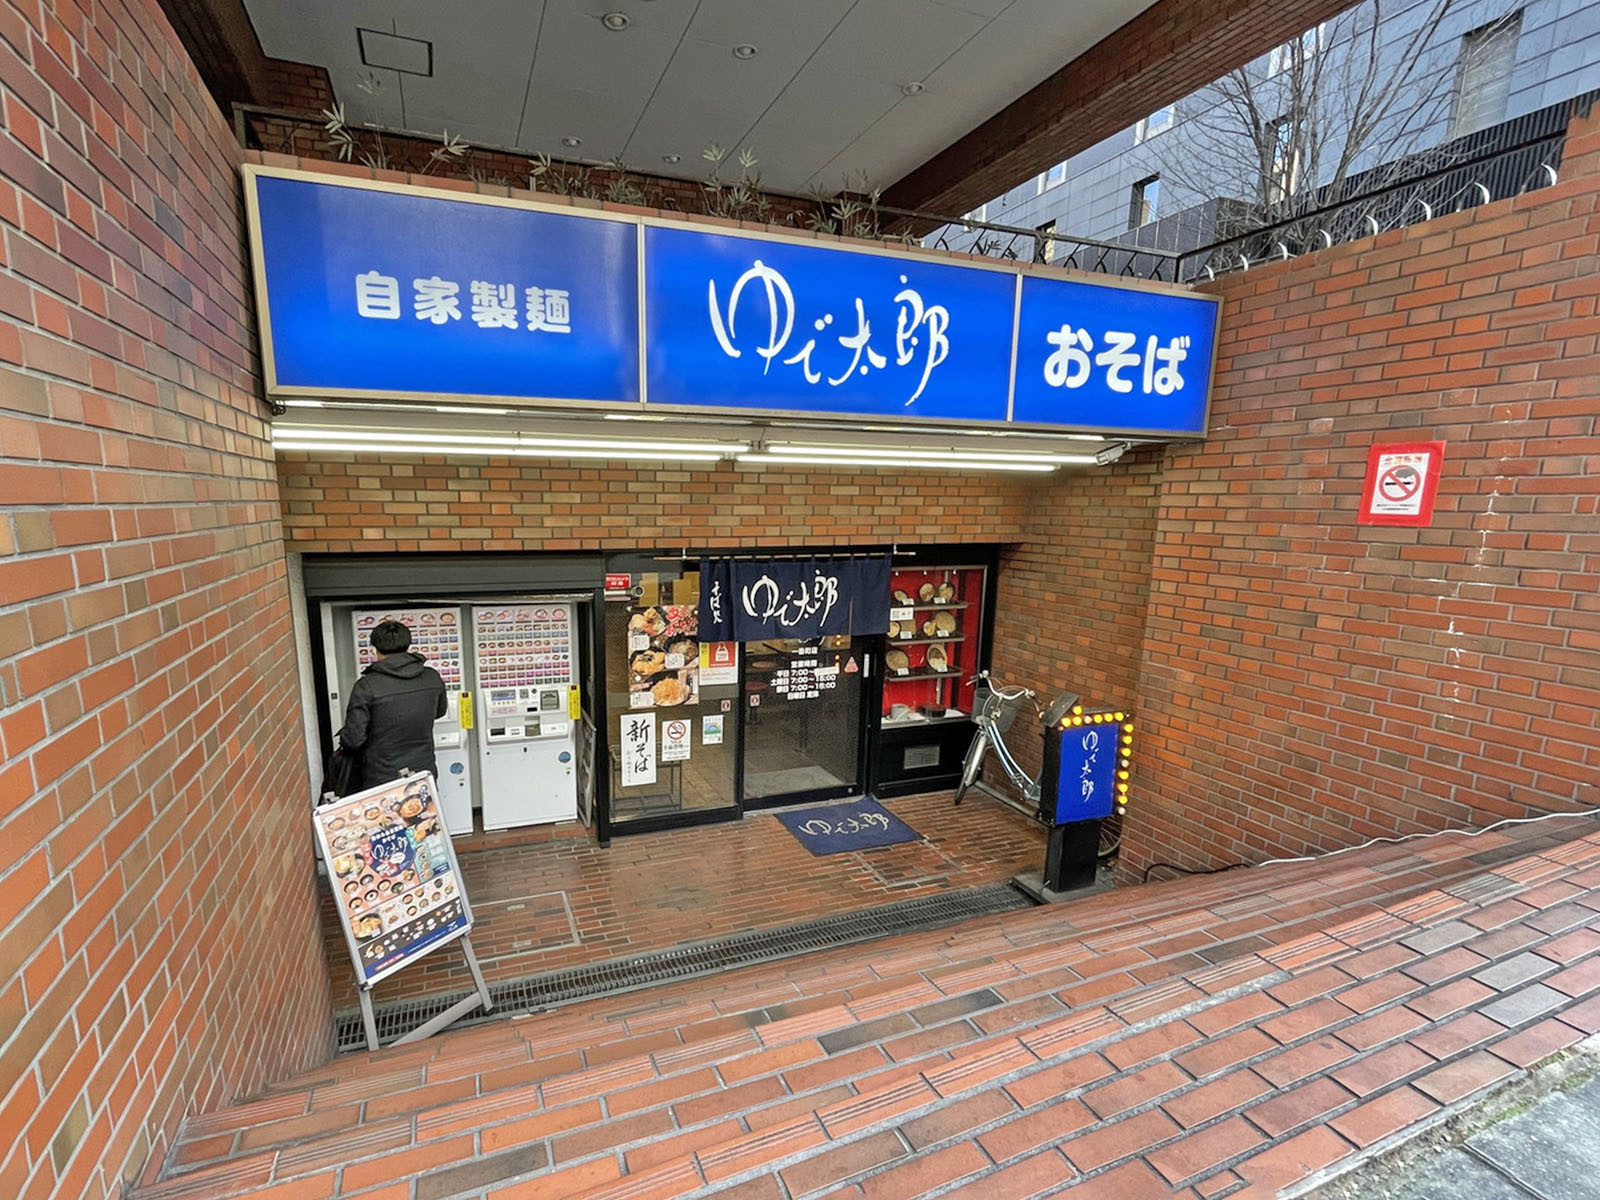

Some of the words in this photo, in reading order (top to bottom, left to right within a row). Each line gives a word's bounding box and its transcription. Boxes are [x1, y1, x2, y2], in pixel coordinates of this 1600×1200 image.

[355, 270, 571, 334] 自家製麺
[708, 260, 950, 407] ゆで太郎
[1043, 324, 1191, 396] おそば
[742, 569, 839, 627] ゆで太郎
[626, 719, 651, 774] 新そば
[1079, 730, 1100, 803] ゆで太郎
[798, 812, 890, 835] ゆで太郎
